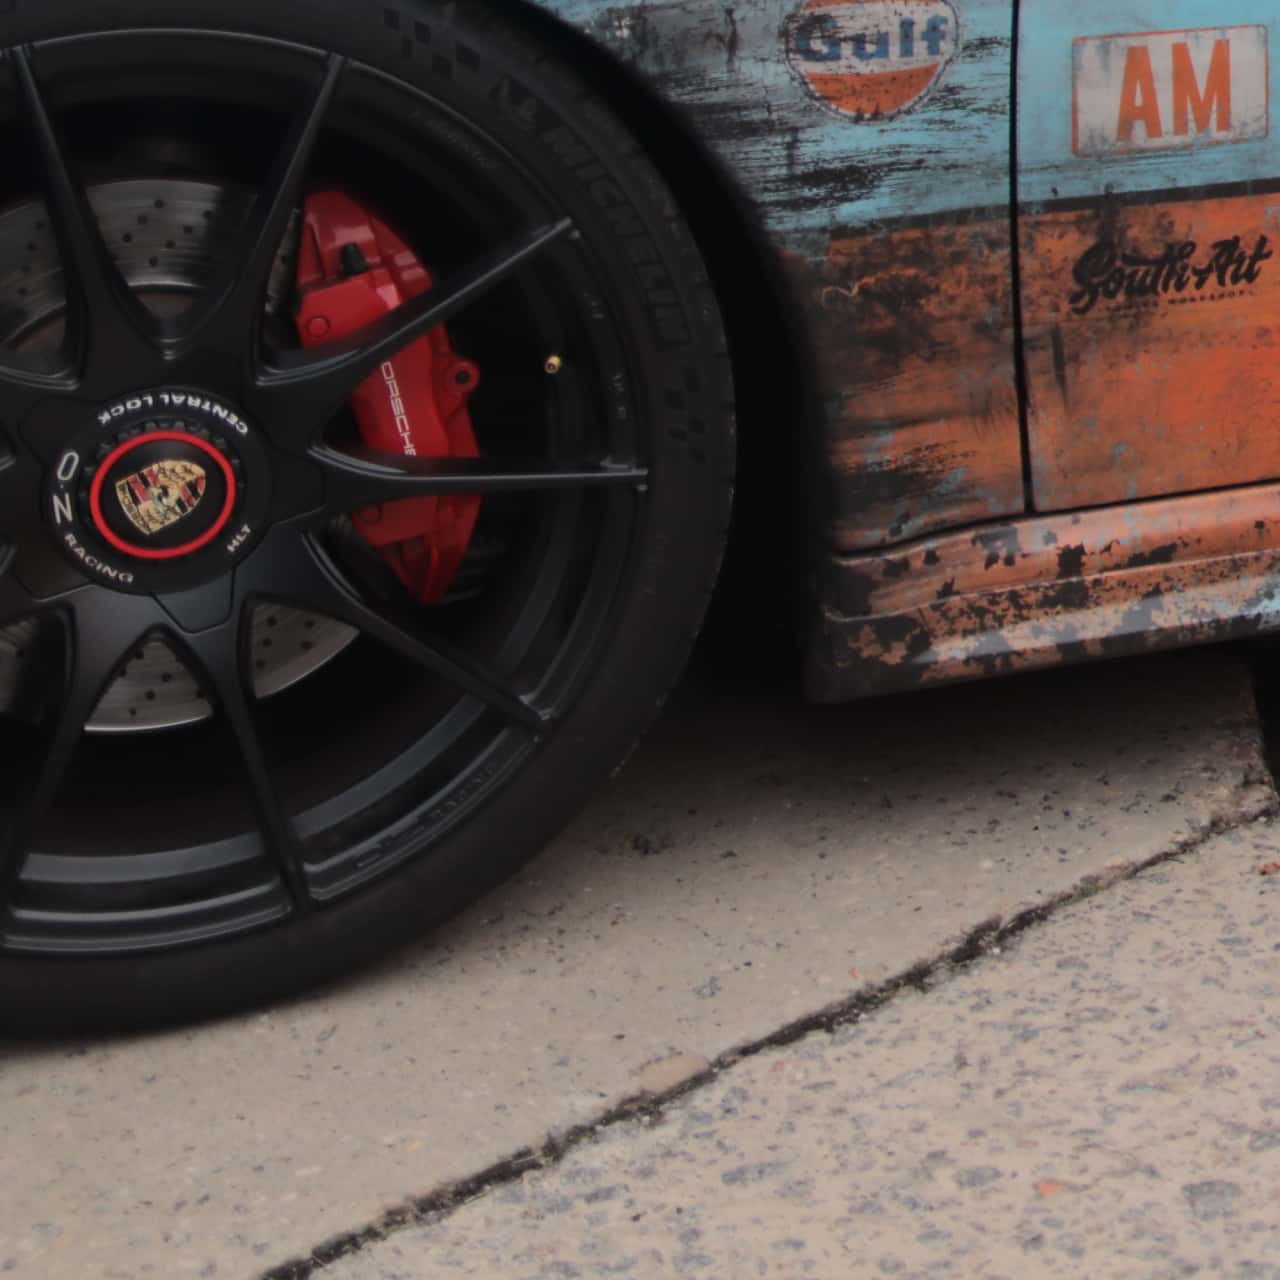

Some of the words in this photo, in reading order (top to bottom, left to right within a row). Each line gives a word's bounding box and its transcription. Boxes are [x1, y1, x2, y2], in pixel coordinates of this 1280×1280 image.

[794, 13, 949, 62] Gulf
[1116, 38, 1231, 142] AM
[97, 393, 153, 425] LOCK
[159, 391, 250, 435] CENTRAL
[380, 360, 417, 457] ORSCHE
[63, 533, 135, 584] RACING
[226, 523, 252, 553] HLT
